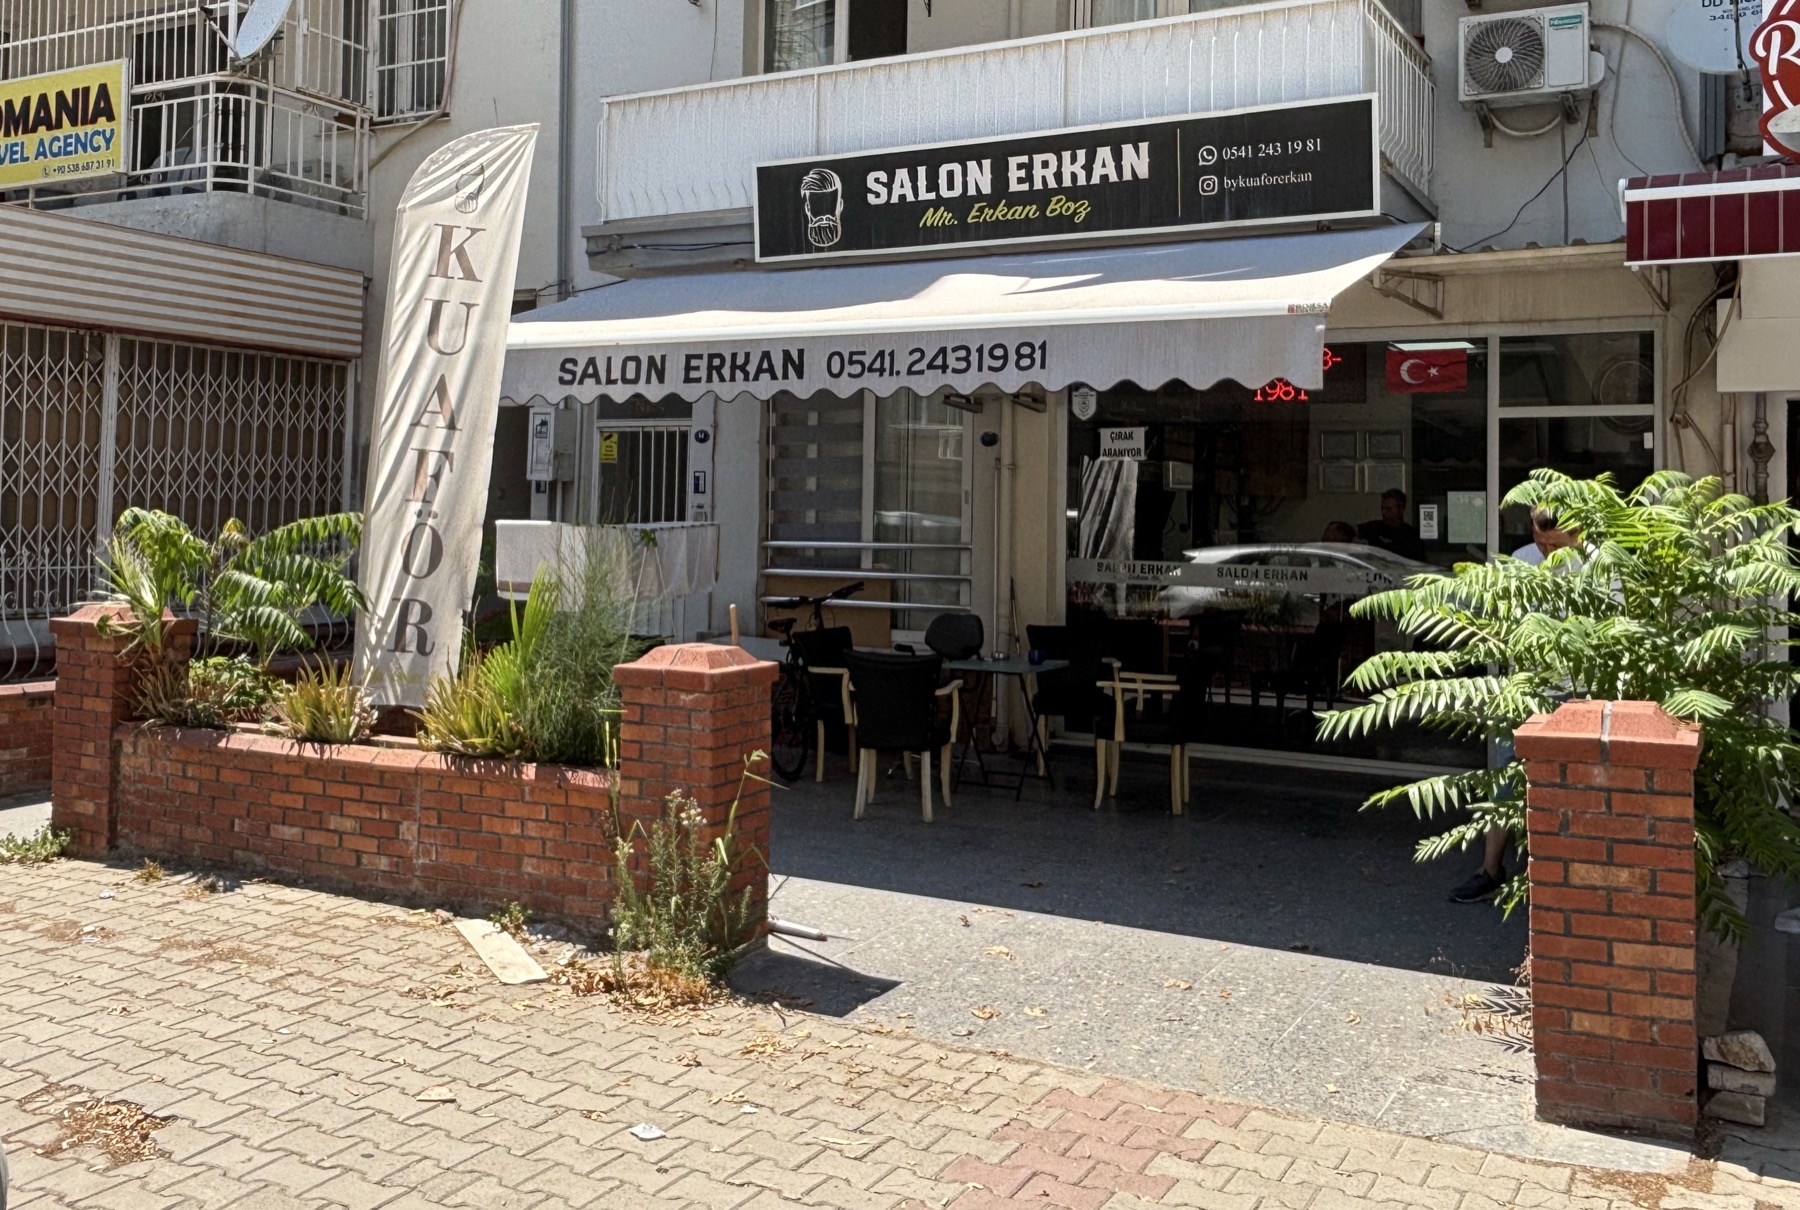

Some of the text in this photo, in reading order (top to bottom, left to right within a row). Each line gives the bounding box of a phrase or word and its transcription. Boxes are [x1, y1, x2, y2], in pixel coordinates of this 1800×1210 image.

[0, 83, 115, 137] MANIA
[35, 129, 115, 160] AGENCY
[1222, 138, 1321, 161] 0541 243 19 81
[866, 141, 1151, 206] SALON ERKAN
[1223, 170, 1313, 191] bykuaforerkan
[919, 194, 1092, 229] Mr. Erkan Boz
[557, 339, 1047, 386] SALON ERKAN 0541.2431981
[386, 223, 486, 658] KUAFÖR
